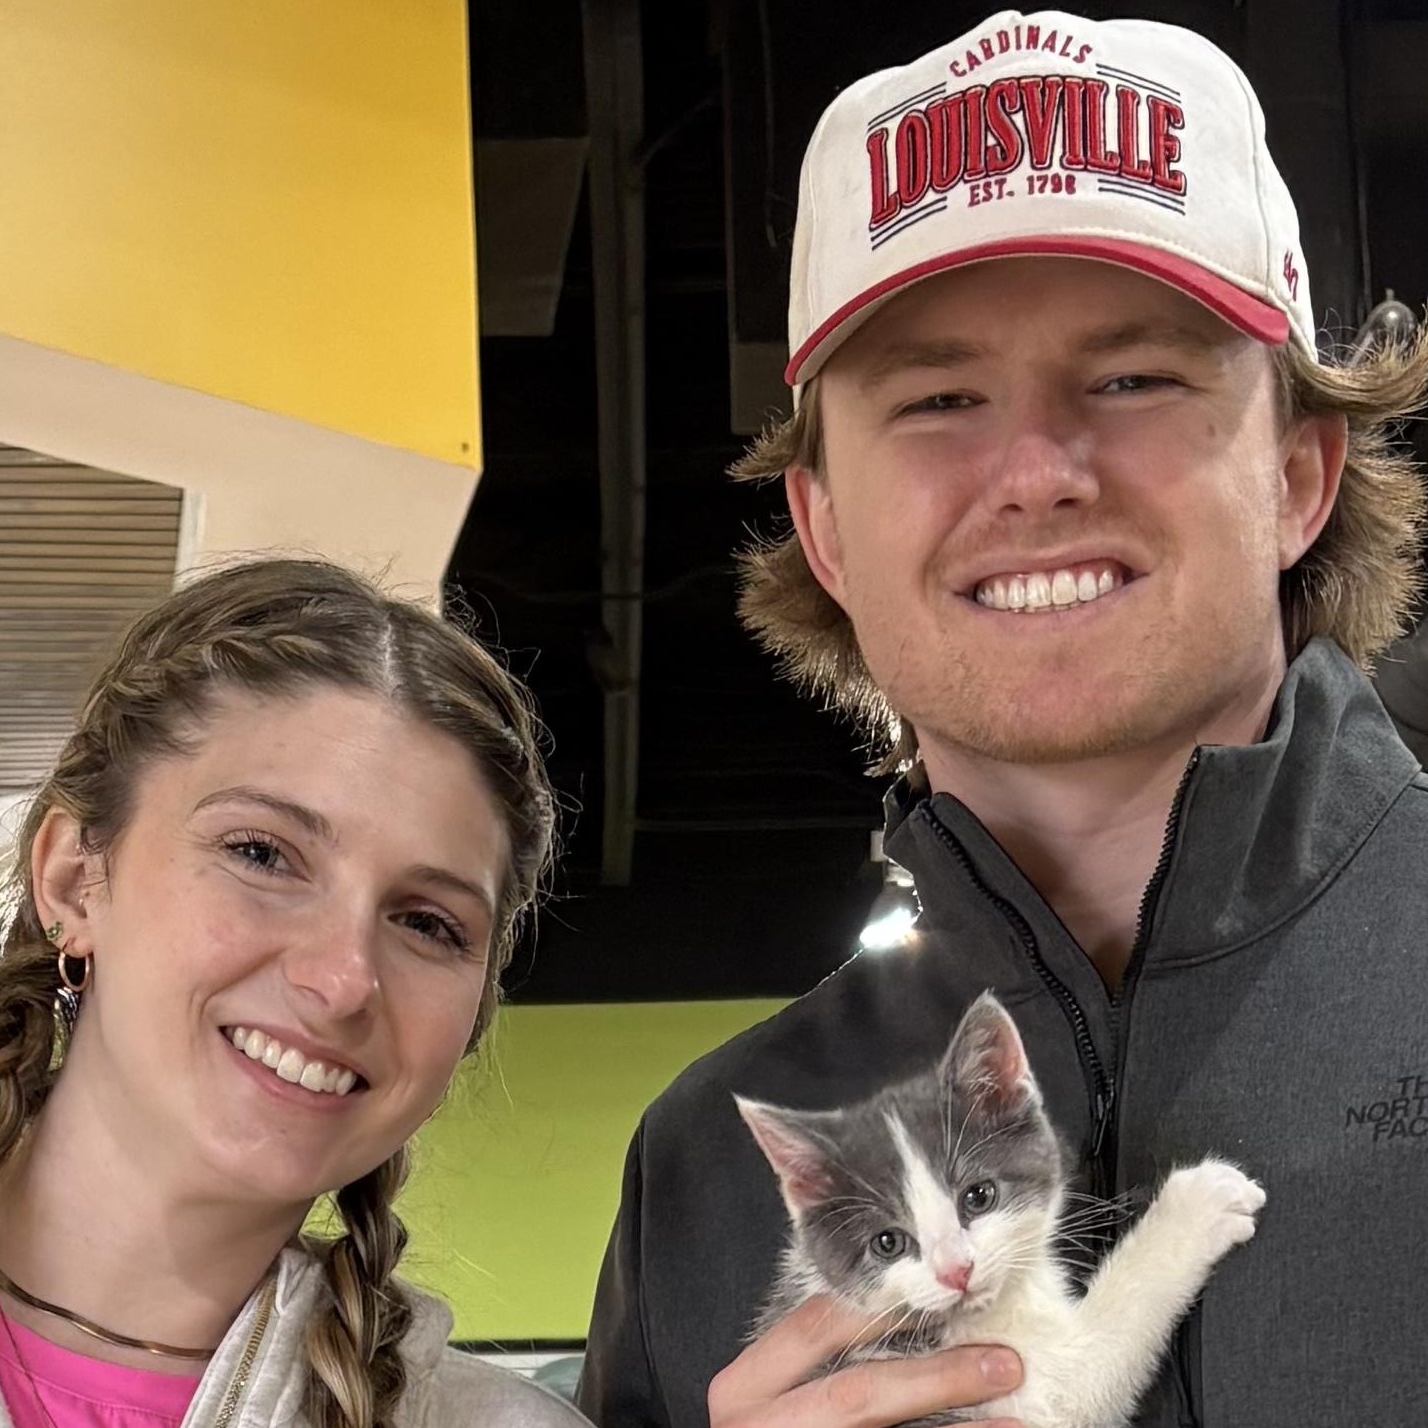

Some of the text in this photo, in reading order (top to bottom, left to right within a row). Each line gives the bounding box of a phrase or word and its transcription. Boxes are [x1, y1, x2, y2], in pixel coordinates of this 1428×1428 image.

[949, 25, 1093, 78] CARDINALS
[867, 74, 1187, 231] LOUISVILLE
[968, 177, 1015, 207] EST.
